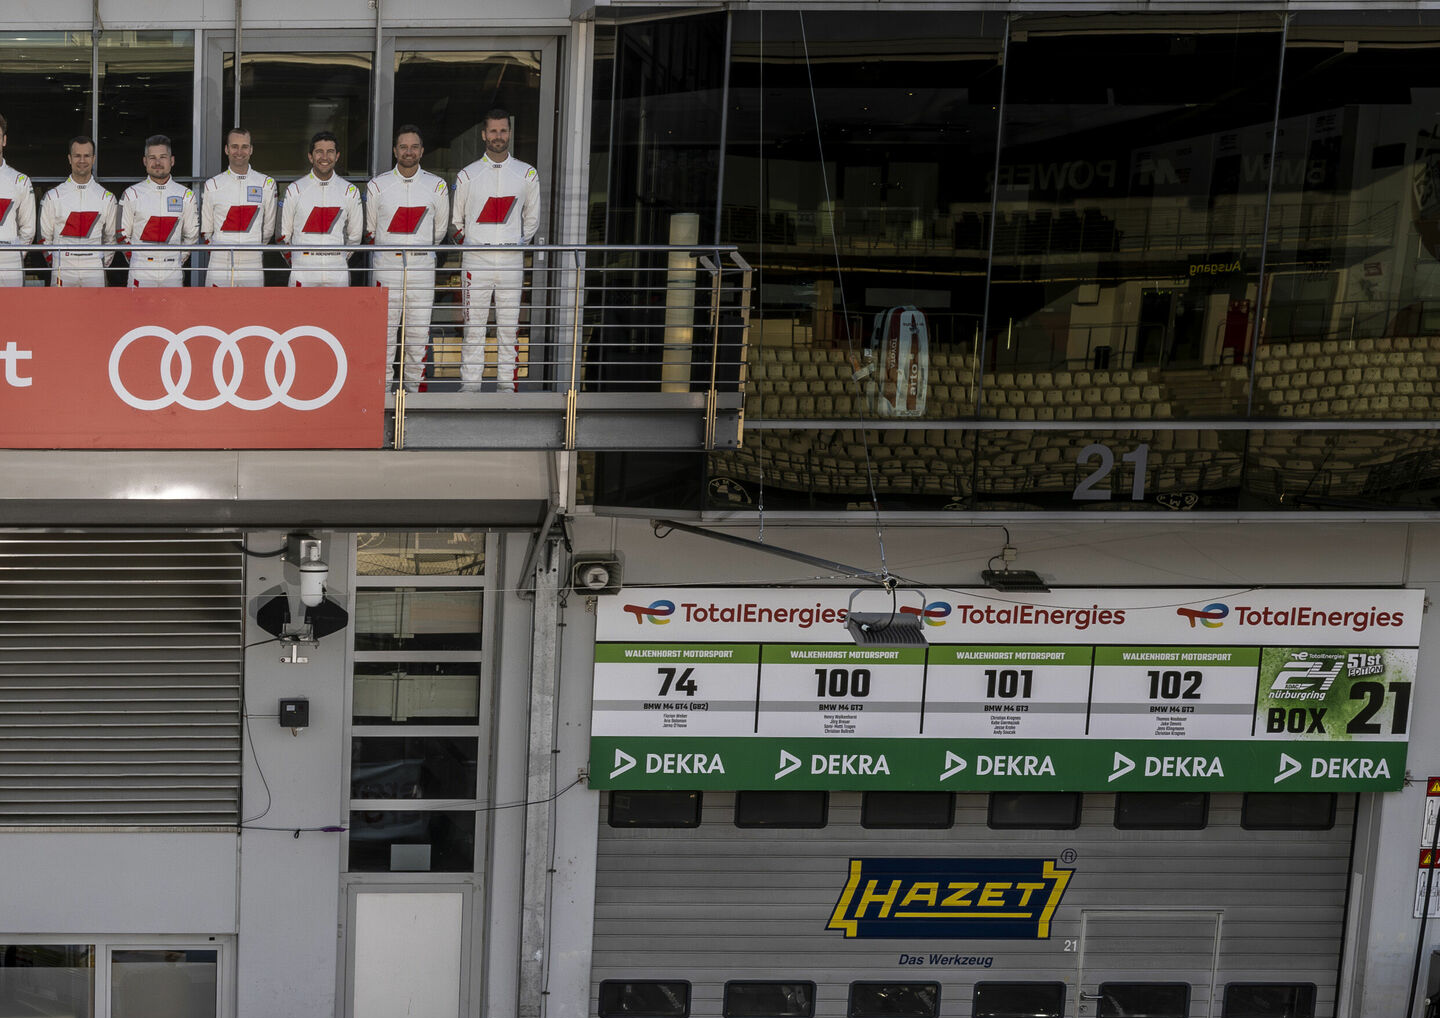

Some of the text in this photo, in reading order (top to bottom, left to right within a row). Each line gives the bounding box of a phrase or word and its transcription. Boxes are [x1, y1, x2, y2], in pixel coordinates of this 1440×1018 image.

[1074, 443, 1151, 501] 21
[681, 603, 849, 628] TotalEnergies
[958, 604, 1126, 630] TotalEnergies
[1235, 606, 1403, 632] TotalEnergies
[625, 650, 733, 658] WALKENHORST MOTORSPORT
[956, 652, 1065, 660] WALKENHORST MOTORSPORT
[1347, 653, 1381, 669] 51st
[658, 668, 697, 696] 74
[815, 669, 871, 697] 100
[984, 670, 1033, 698] 101
[1148, 671, 1202, 699] 102
[1269, 690, 1326, 700] nürburgring
[1266, 682, 1411, 734] BOX 21
[646, 754, 725, 774] DEKRA
[811, 754, 890, 774] DEKRA
[976, 756, 1056, 776] DEKRA
[1144, 756, 1224, 777] DEKRA
[1311, 758, 1390, 778] DEKRA
[854, 880, 1046, 918] HAZET
[1064, 940, 1078, 952] 21
[898, 954, 993, 968] Das Werkzeug
